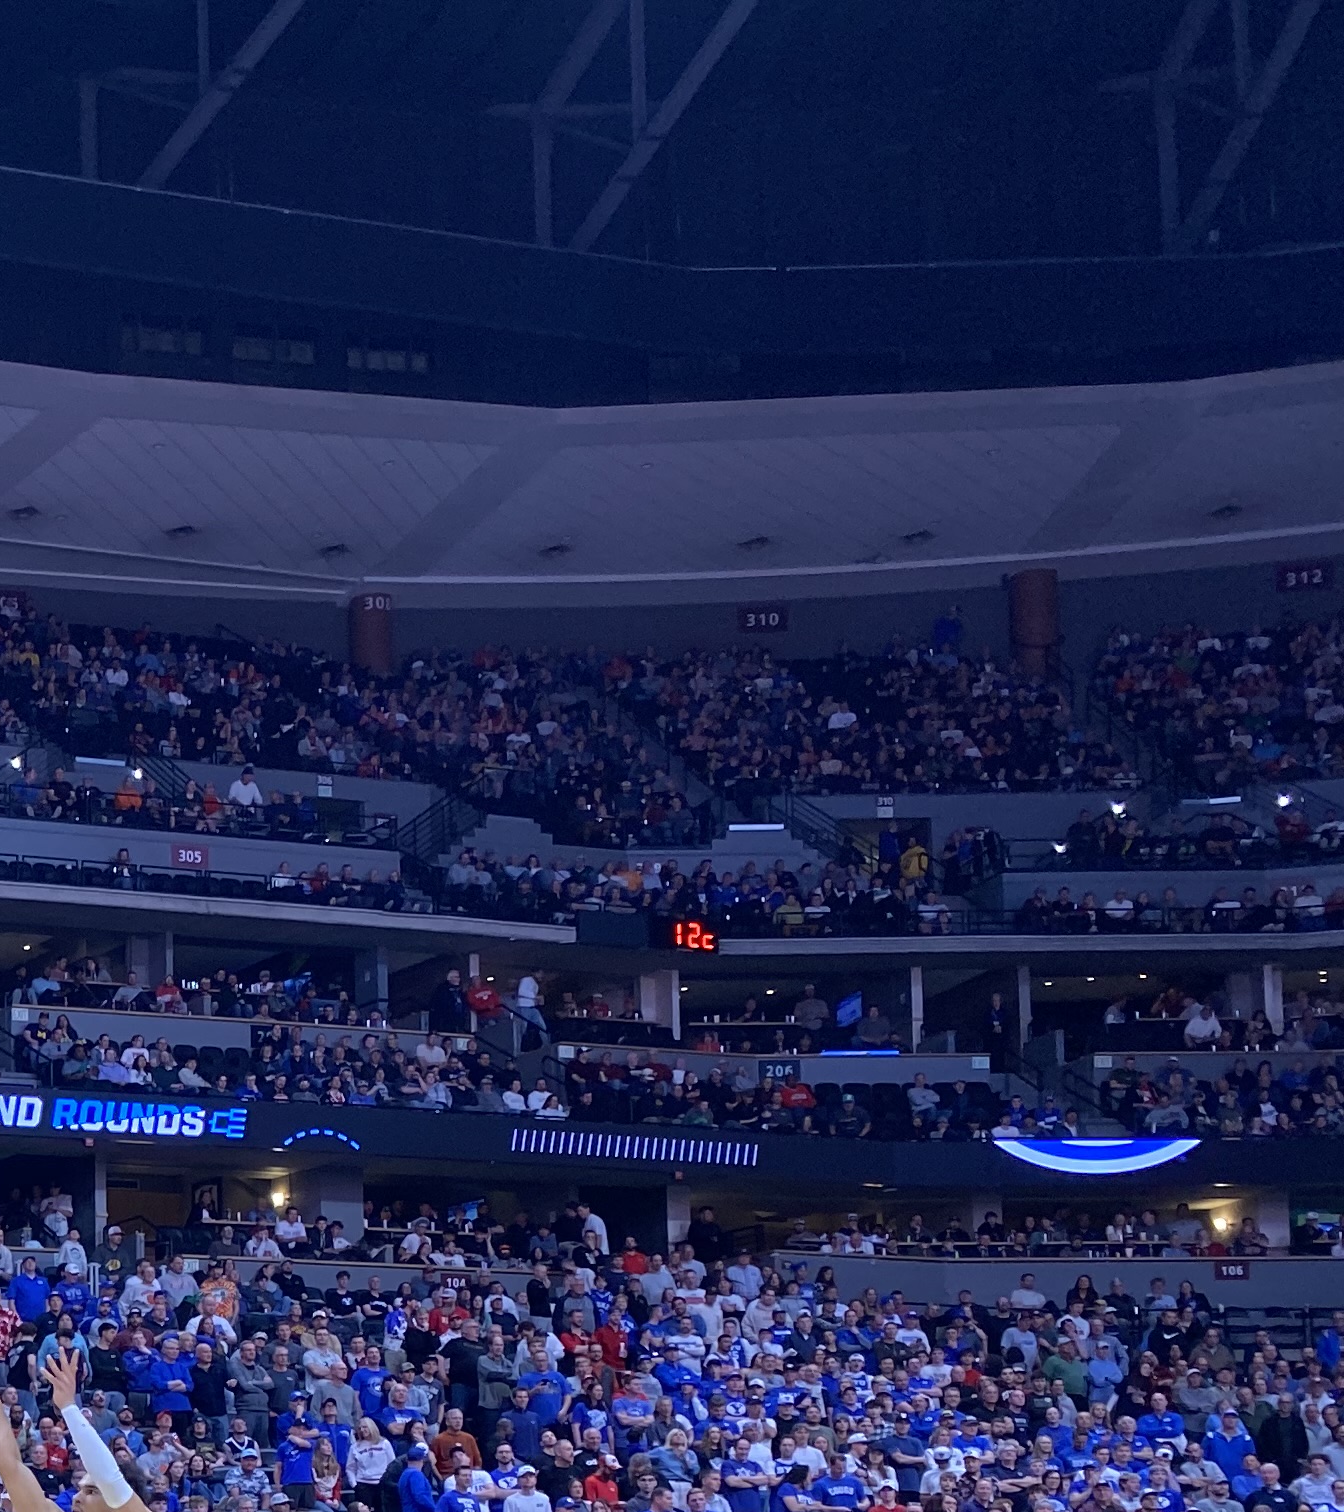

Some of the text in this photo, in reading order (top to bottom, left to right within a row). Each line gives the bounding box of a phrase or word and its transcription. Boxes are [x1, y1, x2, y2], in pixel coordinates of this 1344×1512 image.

[746, 612, 780, 627] 310
[178, 849, 203, 863] 305
[52, 1098, 206, 1137] ROUNDS
[1221, 1265, 1244, 1276] 106
[445, 1277, 467, 1288] 104
